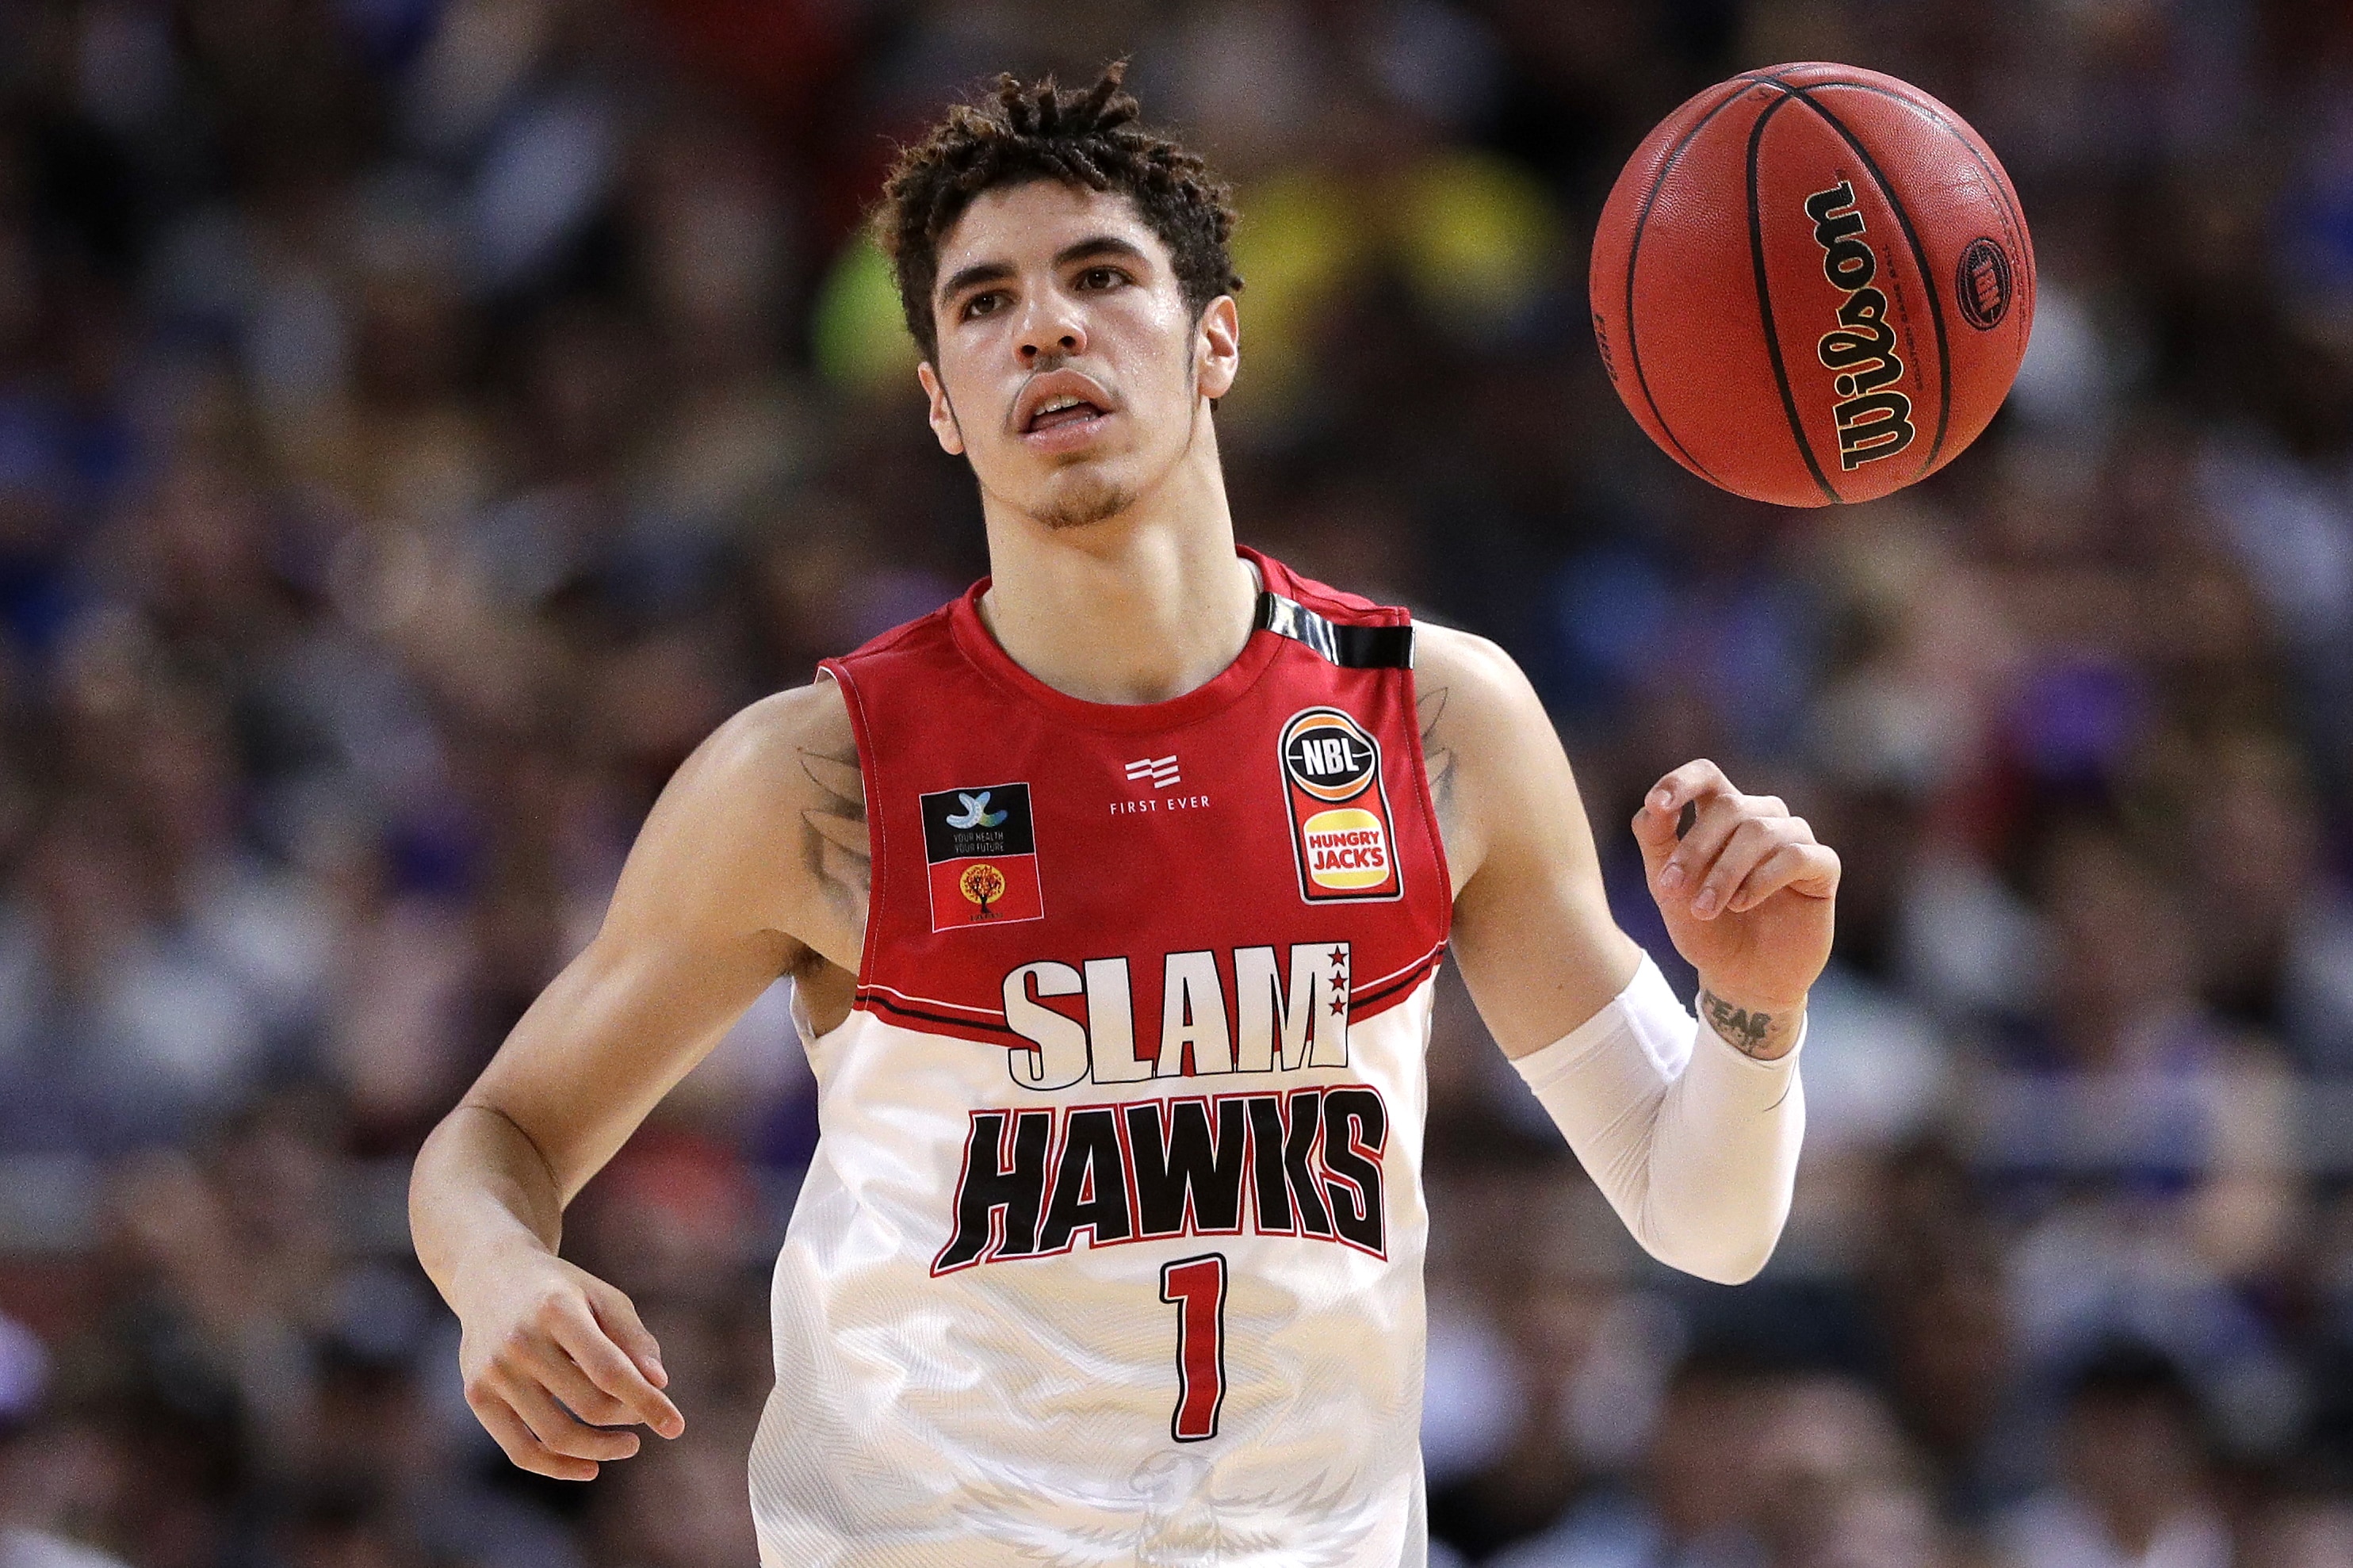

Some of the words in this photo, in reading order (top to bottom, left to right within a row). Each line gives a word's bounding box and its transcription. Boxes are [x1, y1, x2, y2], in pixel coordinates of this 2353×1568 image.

[1972, 255, 2002, 313] NBL
[1805, 181, 1915, 471] Wilson
[1302, 738, 1359, 776] NBL
[1110, 800, 1156, 815] FIRST
[1167, 795, 1210, 810] EVER
[953, 832, 974, 843] YOUR
[975, 832, 1004, 842] HEALTH
[955, 843, 975, 853] YOUR
[977, 841, 1004, 852] FUTURE
[1309, 832, 1379, 849] HUNGRY
[1314, 847, 1384, 870] JACK'S
[1003, 942, 1351, 1091] SLAM
[929, 1084, 1389, 1279] HAWKS
[1159, 1252, 1227, 1443] 1
